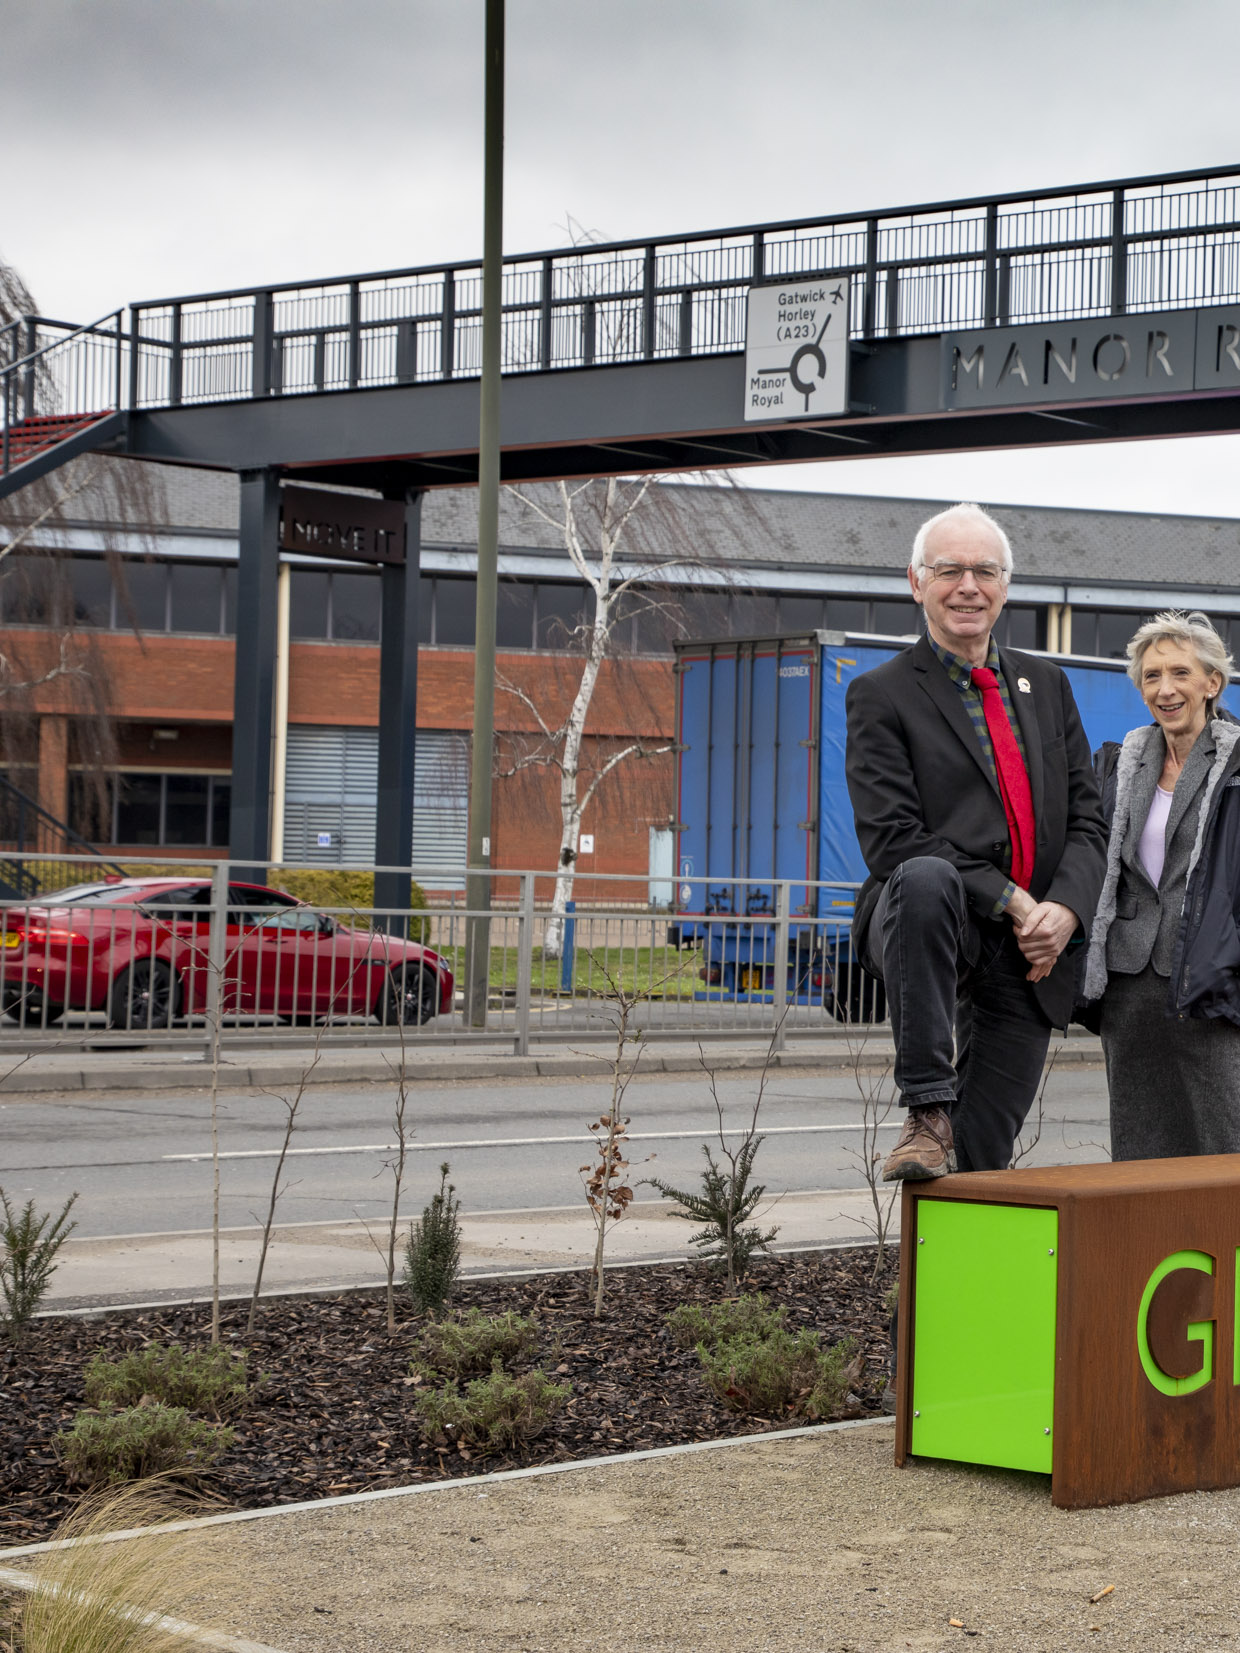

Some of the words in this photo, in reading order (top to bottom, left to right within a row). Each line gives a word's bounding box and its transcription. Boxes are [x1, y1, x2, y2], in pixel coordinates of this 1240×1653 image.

[778, 288, 826, 306] Gatwick
[778, 307, 817, 323] Horley
[776, 323, 817, 342] (A23)
[952, 330, 1174, 390] MANOR
[750, 377, 787, 390] Manor
[751, 392, 784, 408] Royal
[292, 518, 365, 551] MOVE
[374, 527, 397, 554] IT
